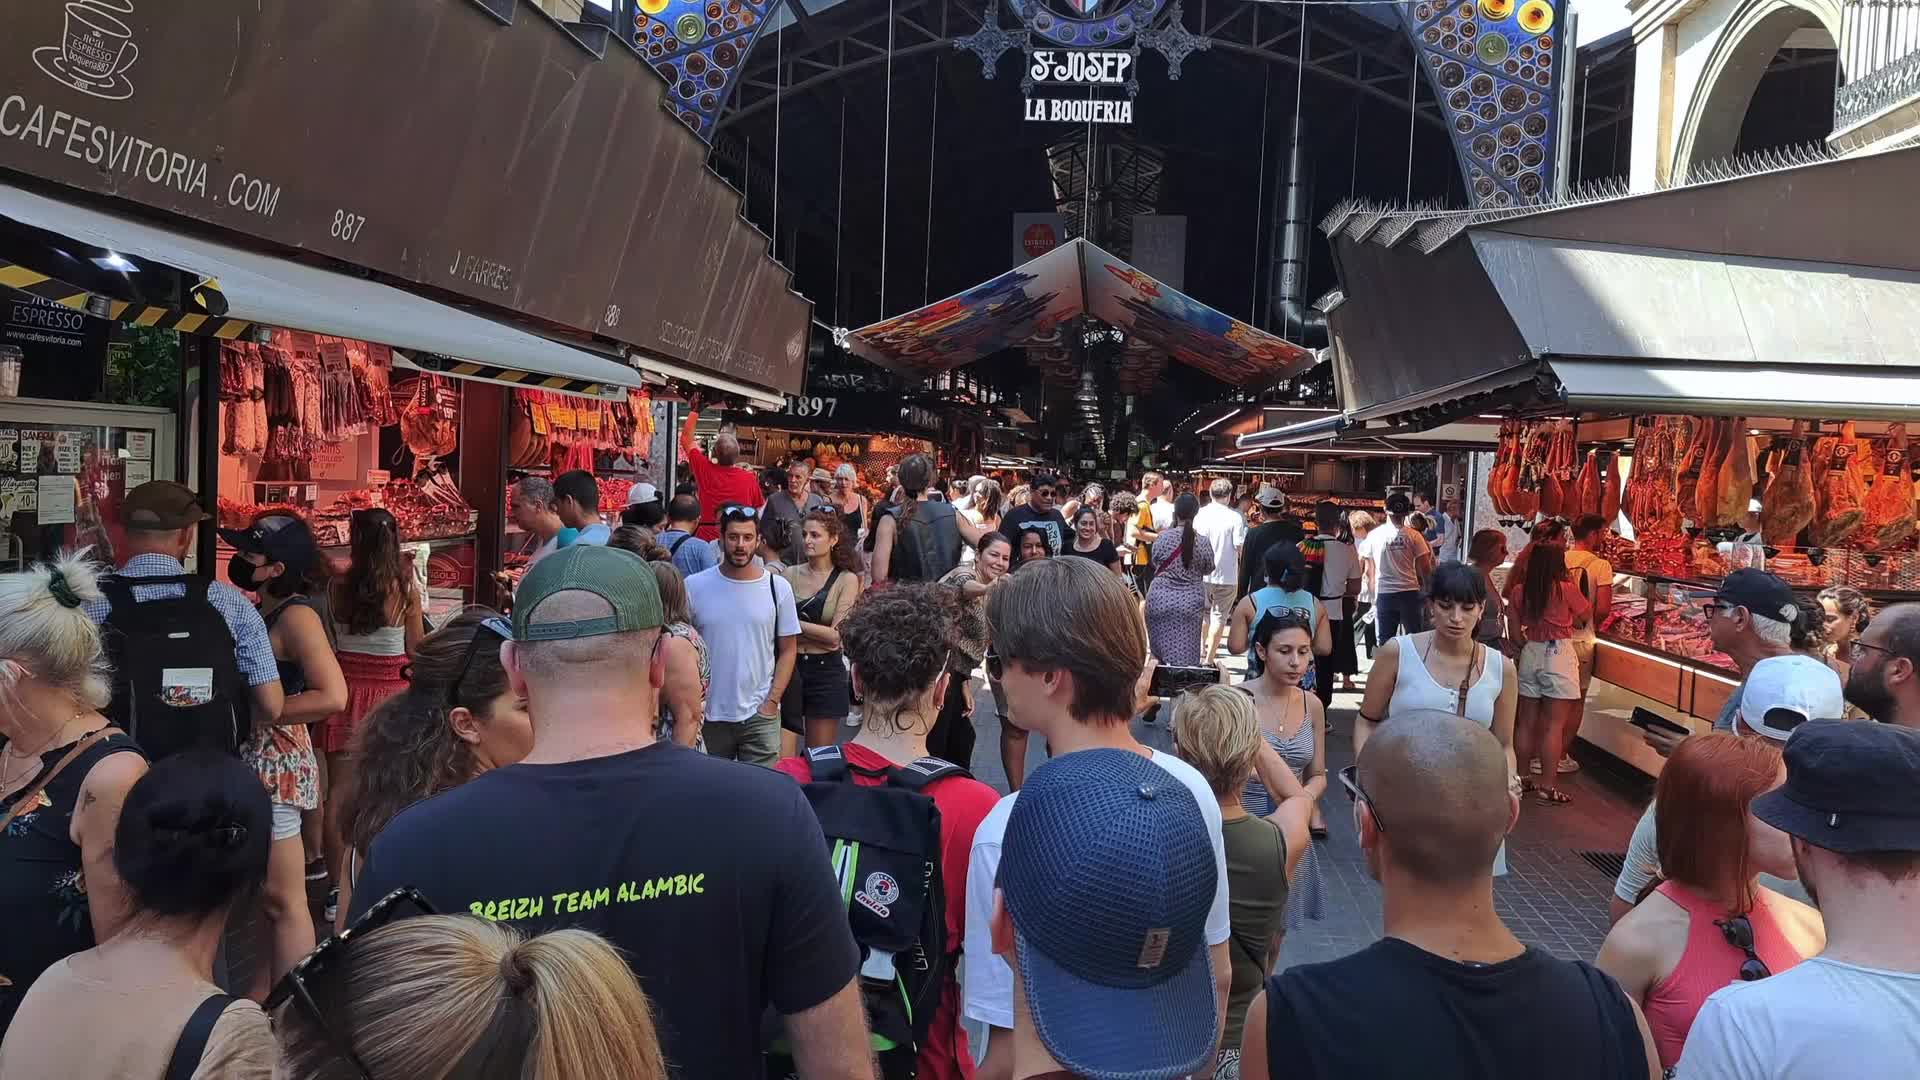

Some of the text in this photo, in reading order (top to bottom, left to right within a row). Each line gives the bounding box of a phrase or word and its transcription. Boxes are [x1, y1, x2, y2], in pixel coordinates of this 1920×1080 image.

[69, 49, 109, 73] boqueria887
[72, 39, 112, 61] ESPRESSO
[1053, 52, 1131, 82] JOSEP
[1025, 99, 1132, 123] LA BOQUERIA
[330, 208, 366, 244] 887
[12, 305, 83, 330] ESPRESSO
[6, 330, 82, 348] www.cafesvitoria.com
[785, 396, 838, 418] 1897
[470, 873, 705, 922] BREIZH TEAM ALAMBIC
